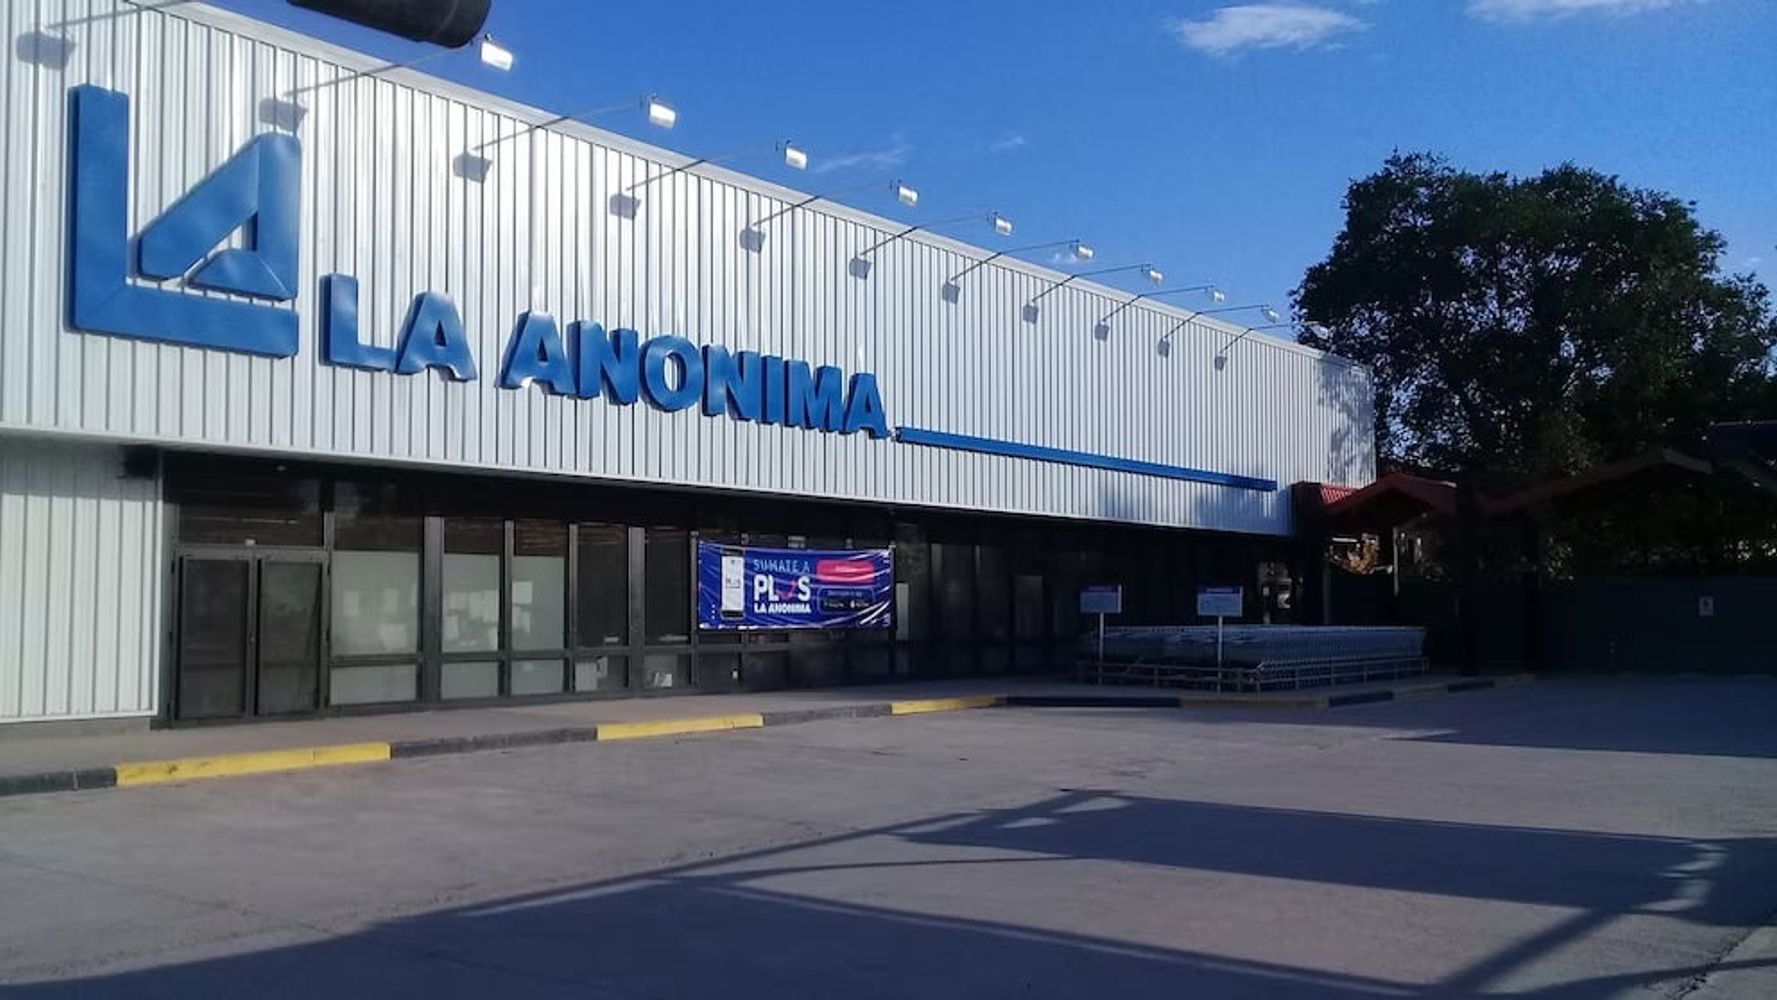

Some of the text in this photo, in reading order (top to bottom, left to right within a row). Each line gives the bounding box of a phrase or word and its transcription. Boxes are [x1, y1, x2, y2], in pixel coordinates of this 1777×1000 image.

[320, 273, 887, 439] LA ANONIMA
[753, 559, 811, 573] SUMATE A
[754, 603, 811, 614] LA ANONIMA
